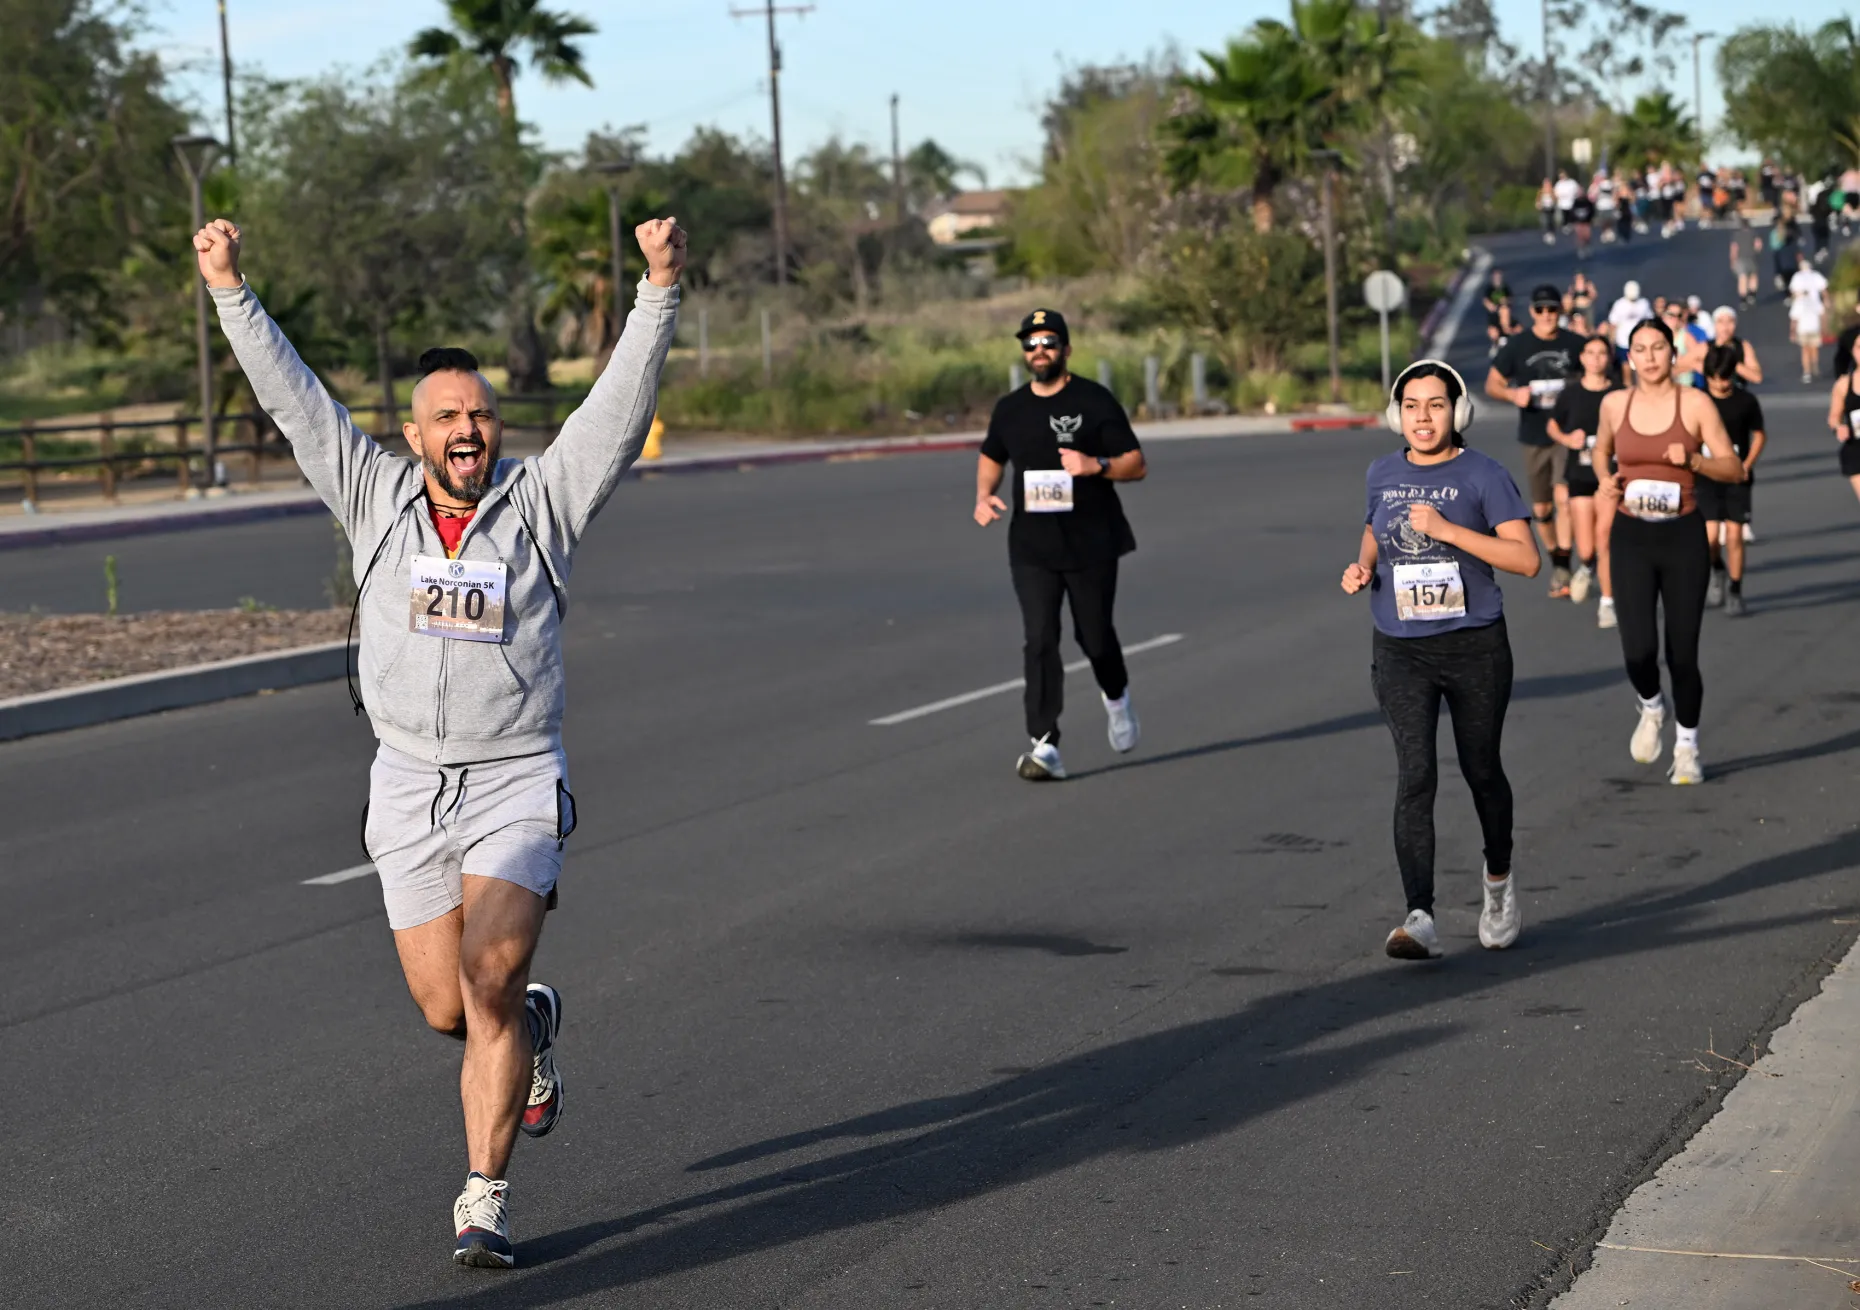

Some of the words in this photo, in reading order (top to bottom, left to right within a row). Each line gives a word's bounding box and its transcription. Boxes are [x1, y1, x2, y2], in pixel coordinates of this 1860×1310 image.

[420, 575, 438, 585] Lake
[439, 578, 481, 589] Norconian
[483, 581, 494, 589] 5K
[426, 584, 485, 621] 210
[1409, 583, 1449, 607] 157
